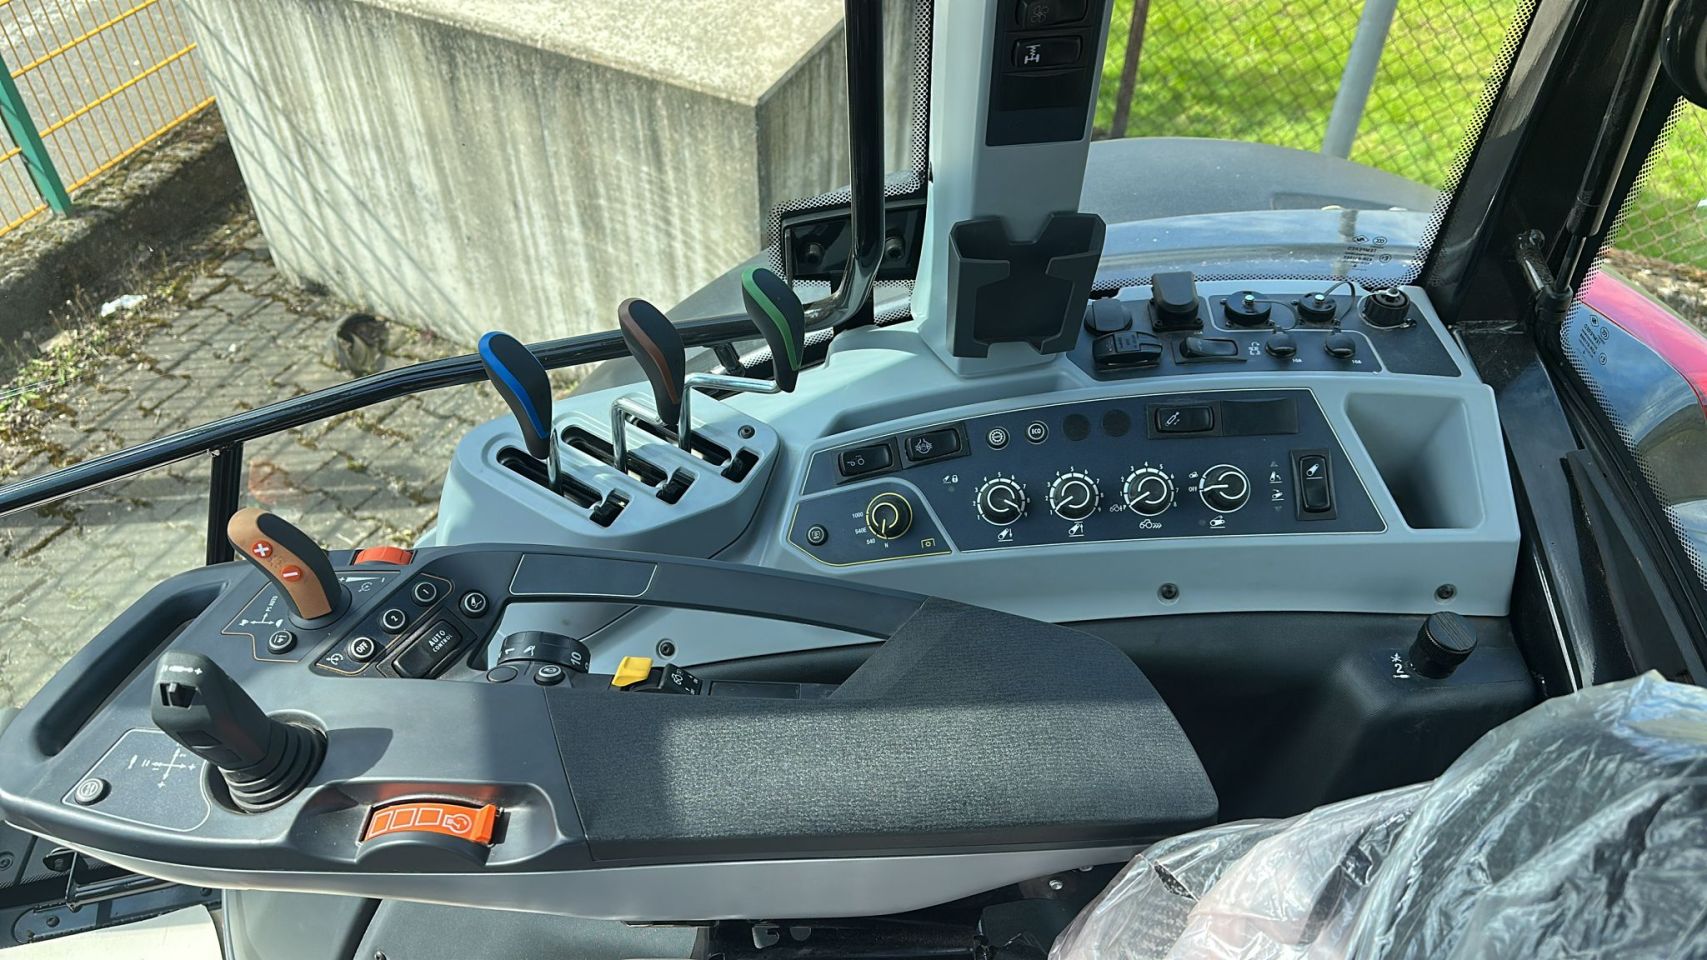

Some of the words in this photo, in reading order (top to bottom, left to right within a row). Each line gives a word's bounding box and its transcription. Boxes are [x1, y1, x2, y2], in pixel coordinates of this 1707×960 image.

[852, 511, 864, 519] 1000
[854, 527, 867, 535] 540E
[428, 630, 446, 647] AUTO
[432, 634, 453, 653] CONTROL
[355, 641, 369, 653] OFF
[570, 651, 582, 666] 10
[1394, 663, 1404, 674] 2
